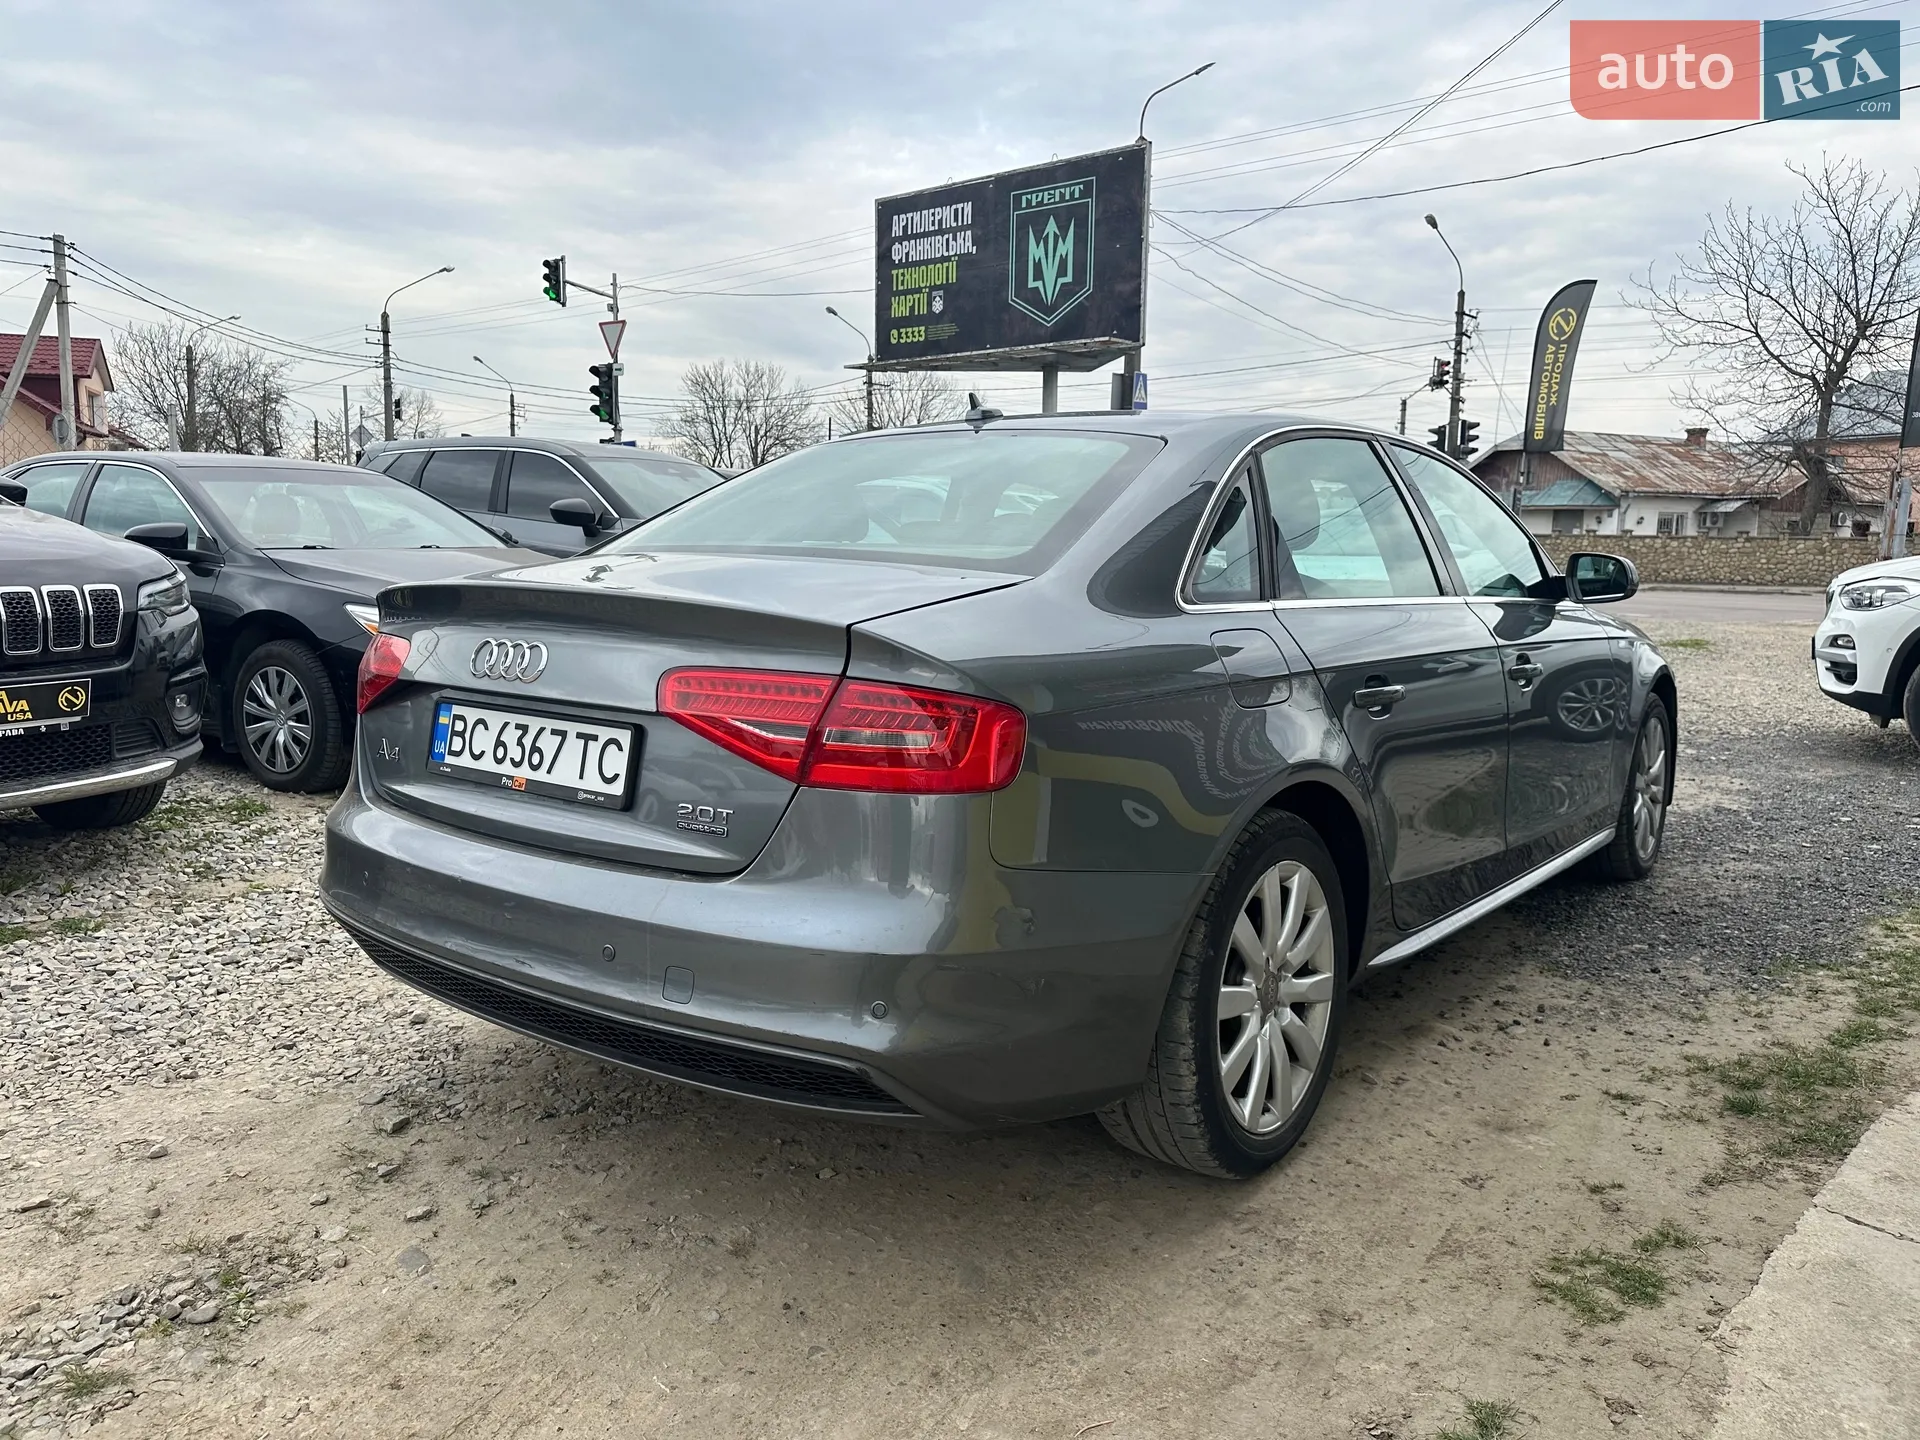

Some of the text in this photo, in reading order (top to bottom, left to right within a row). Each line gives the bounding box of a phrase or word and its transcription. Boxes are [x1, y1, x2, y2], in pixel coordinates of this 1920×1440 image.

[892, 201, 972, 237] АРТИЛЕРИСТИ
[892, 230, 977, 264] ФРАНКІВСЬКА,
[891, 256, 958, 291] ТЕХНОЛОГІЇ
[890, 288, 929, 318] ХАРТІЇ
[900, 326, 926, 343] 3333
[1549, 343, 1568, 406] ПРОДАЖ
[1533, 343, 1556, 440] АВТОМОБІЛІВ
[7, 711, 33, 721] USA
[376, 737, 400, 762] A4
[434, 739, 445, 755] UA
[447, 713, 624, 785] BC 6367 TC
[677, 821, 725, 835] quattro
